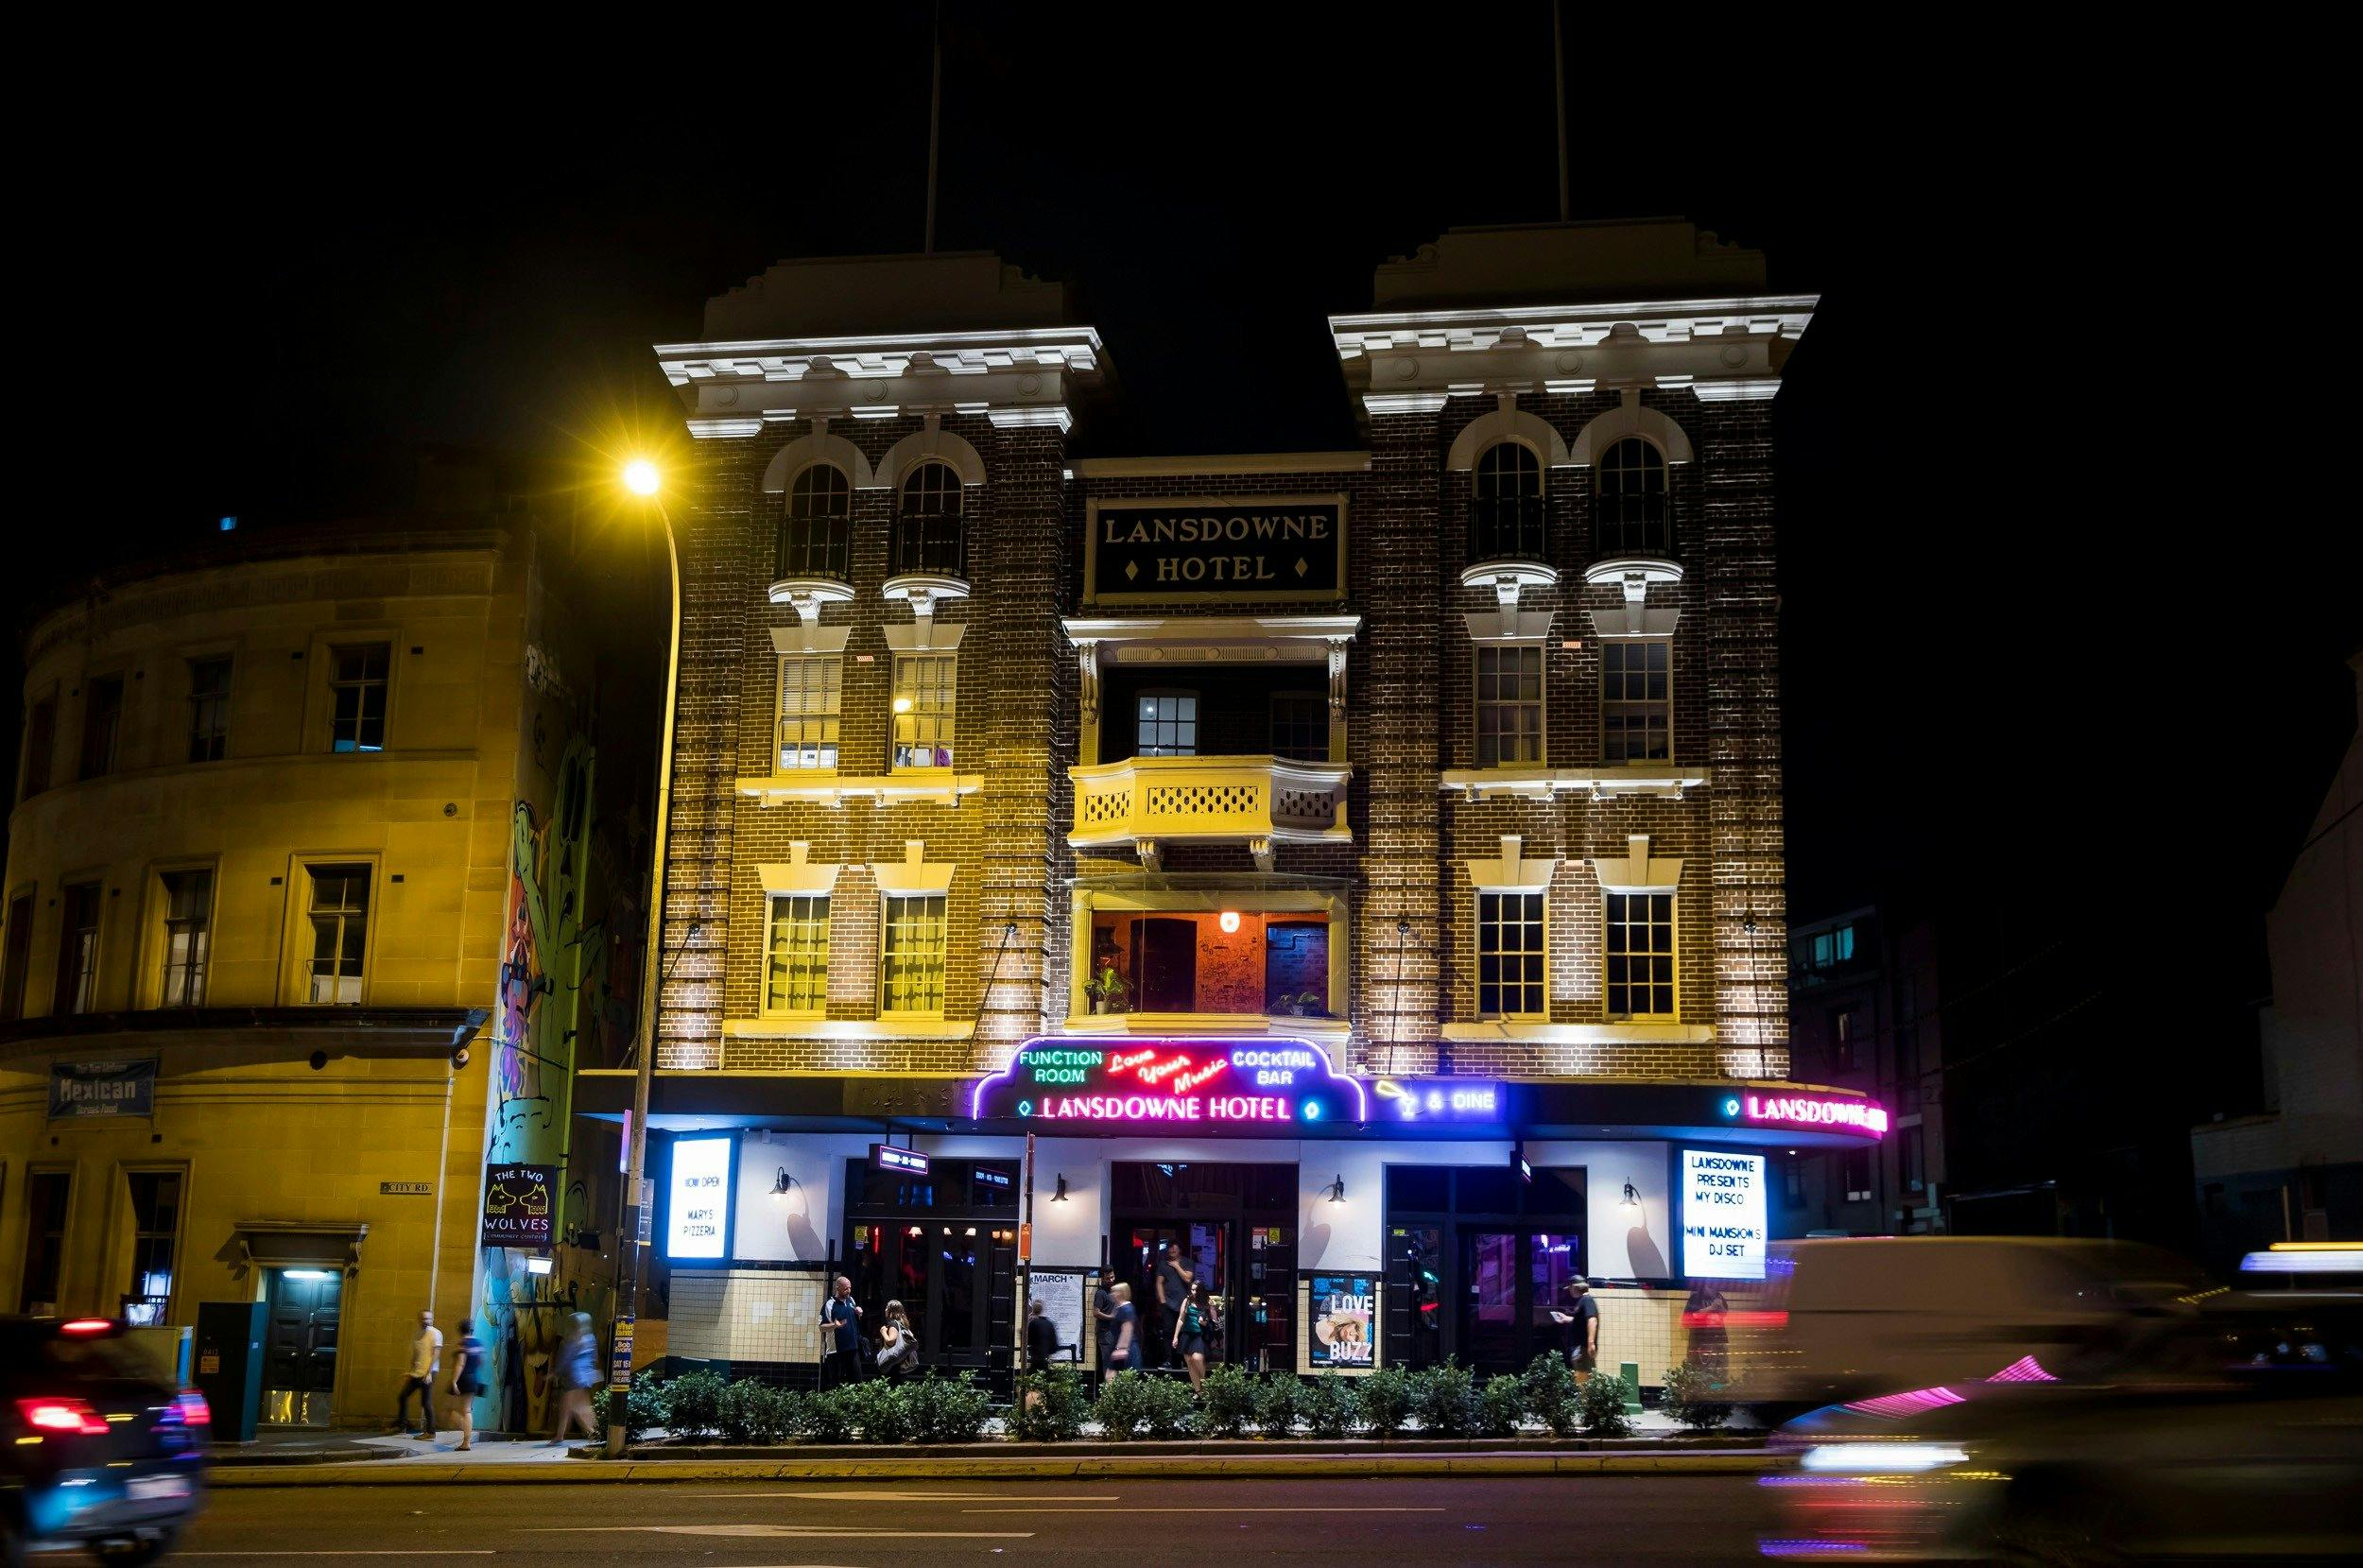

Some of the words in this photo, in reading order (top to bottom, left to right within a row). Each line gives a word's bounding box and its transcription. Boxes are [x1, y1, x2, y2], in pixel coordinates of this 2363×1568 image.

[1105, 515, 1329, 543] LANSDOWNE
[1156, 556, 1276, 582] HOTEL
[1019, 1051, 1103, 1065] FUNCTION
[1107, 1049, 1156, 1073] Love
[1233, 1051, 1316, 1067] COCKTAIL
[1035, 1069, 1085, 1083] ROOM
[1138, 1055, 1191, 1084] Your
[1173, 1058, 1228, 1094] Music
[1256, 1070, 1292, 1085] BAR
[60, 1078, 136, 1102] Mexican
[1043, 1096, 1200, 1119] LANSDOWNE
[1209, 1096, 1291, 1119] HOTEL
[1453, 1093, 1494, 1109] DINE
[1749, 1095, 1867, 1126] LANSDOWNE
[1691, 1156, 1755, 1172] LANSDOWNE
[494, 1170, 516, 1181] THE
[520, 1169, 543, 1182] TWO
[701, 1177, 720, 1188] OPEN
[1697, 1173, 1750, 1188] PRESENTS
[415, 1183, 428, 1192] RD
[1695, 1191, 1710, 1203] MY
[1714, 1192, 1744, 1205] DISCO
[484, 1217, 549, 1231] WOLVES
[682, 1225, 716, 1237] PIZZERIA
[1685, 1225, 1705, 1237] MINI
[1709, 1226, 1761, 1240] MANSIONS
[1709, 1244, 1723, 1255] DJ
[1726, 1244, 1745, 1256] SET
[1034, 1274, 1068, 1283] MARCH
[1331, 1294, 1373, 1315] LOVE
[1330, 1341, 1372, 1361] BUZZ
